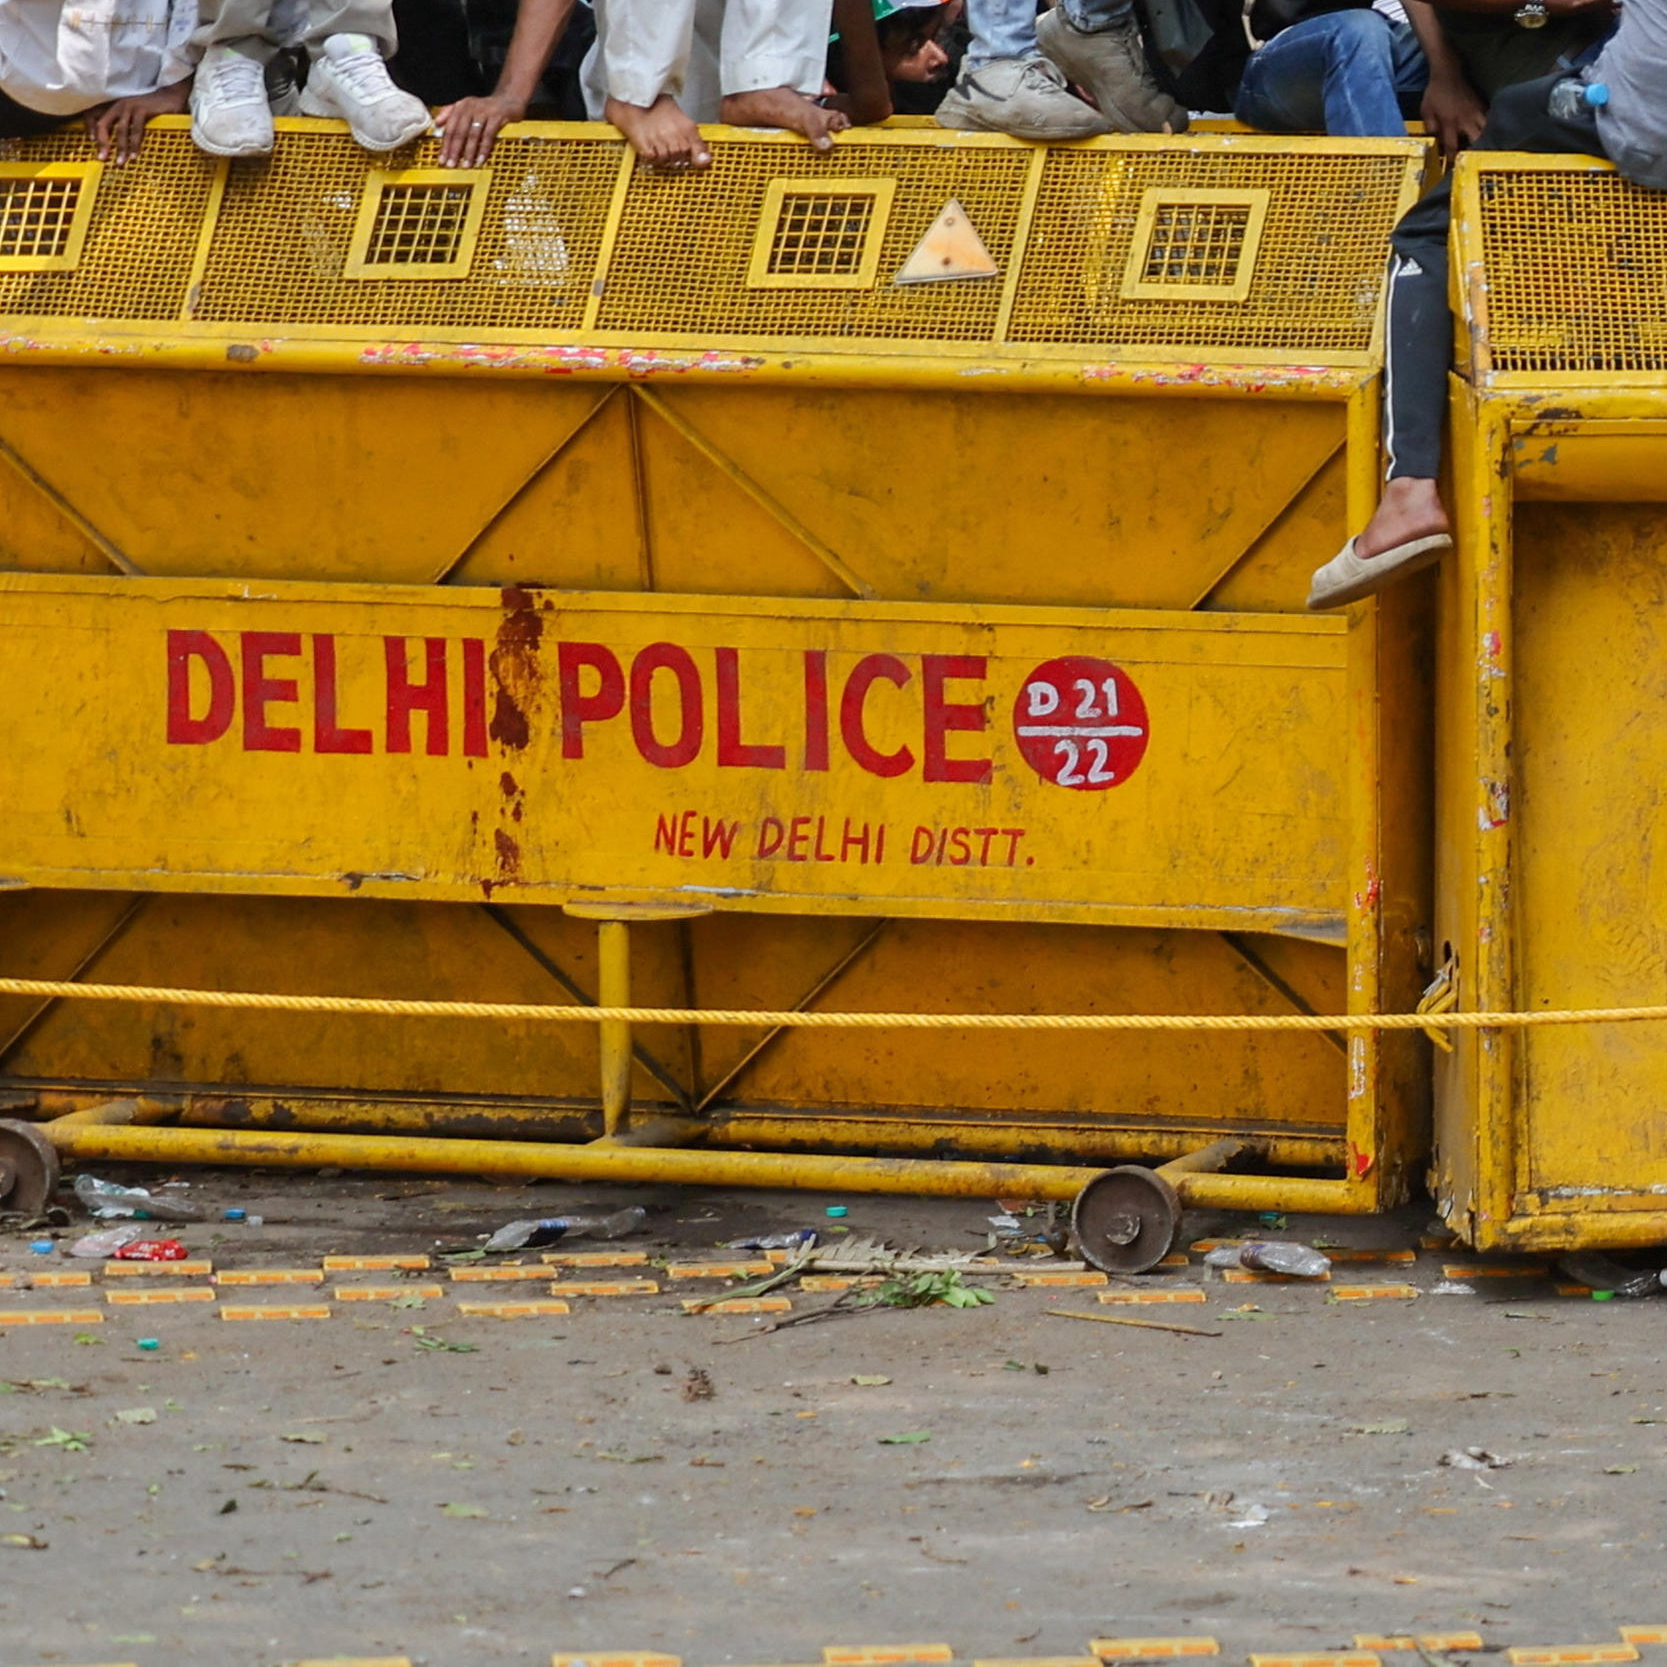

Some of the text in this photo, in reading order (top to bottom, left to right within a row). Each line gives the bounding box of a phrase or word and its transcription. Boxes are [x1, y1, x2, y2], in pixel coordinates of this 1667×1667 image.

[166, 629, 993, 784] DELHI POLICE
[1027, 678, 1119, 719] D 21
[1054, 739, 1114, 786] 22
[654, 810, 1036, 867] NEW DELHI DISTT.
